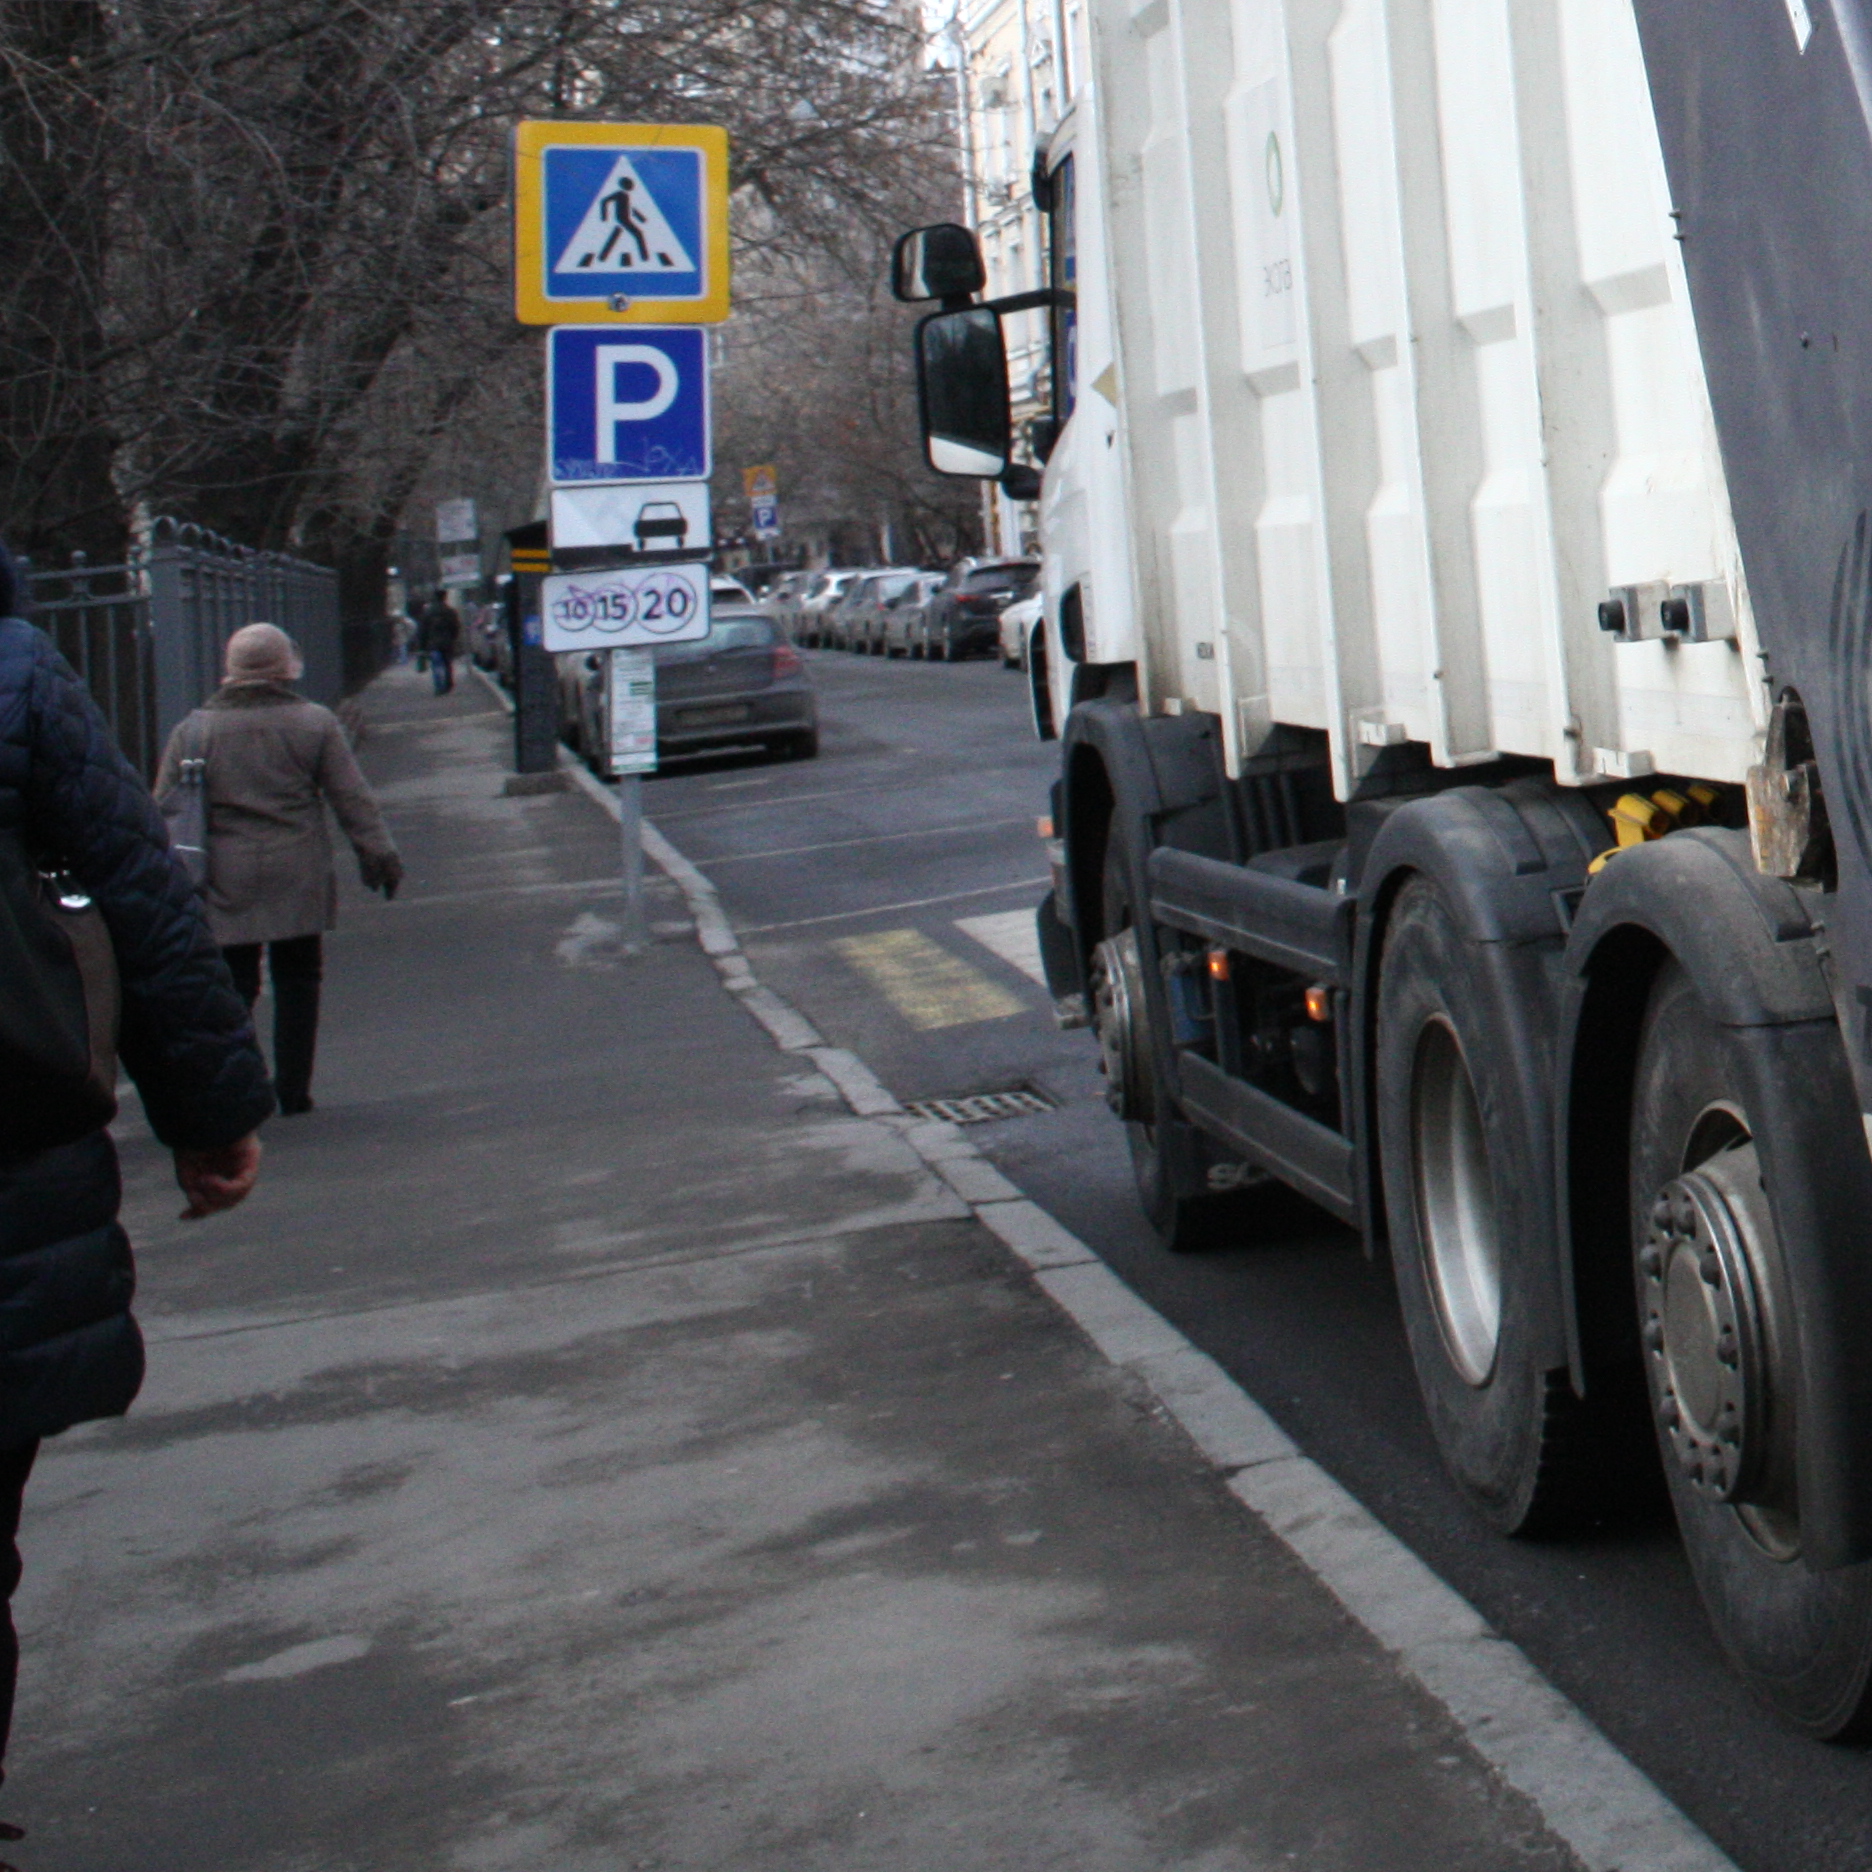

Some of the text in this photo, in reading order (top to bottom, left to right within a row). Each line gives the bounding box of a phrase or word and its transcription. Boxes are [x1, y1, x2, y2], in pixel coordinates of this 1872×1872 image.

[594, 343, 680, 465] P
[597, 593, 628, 620] 15
[643, 588, 689, 621] 20
